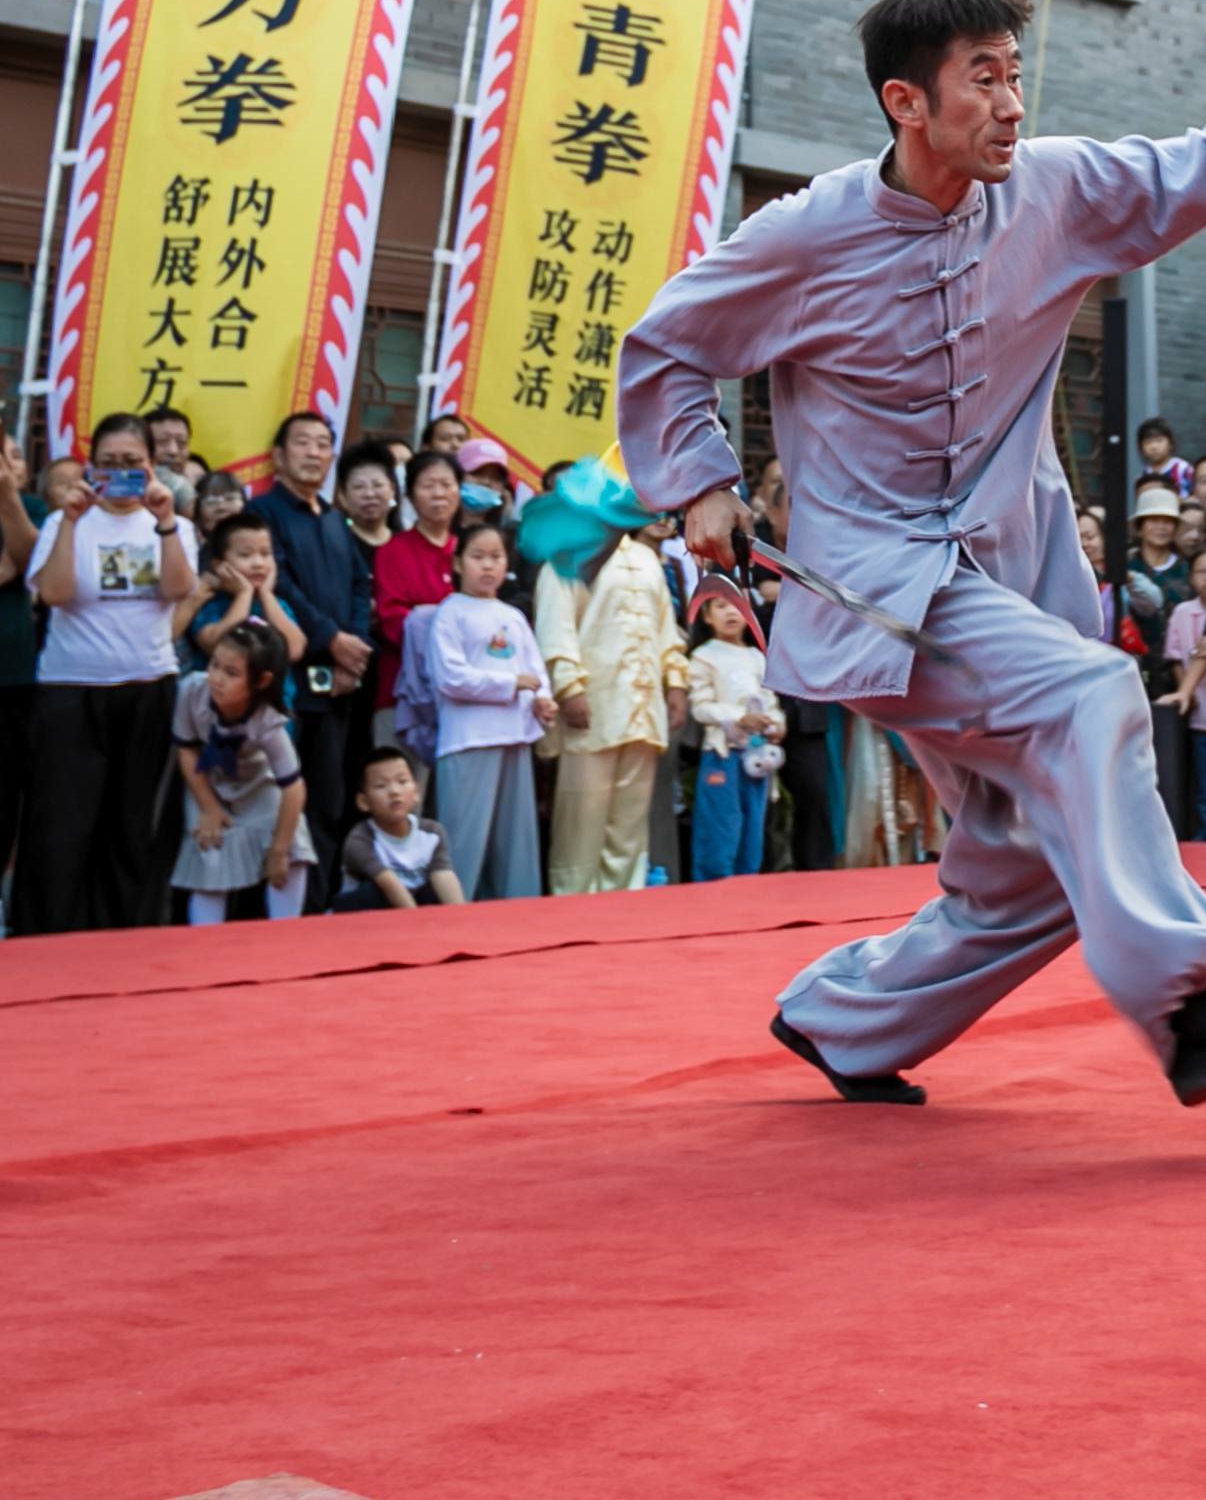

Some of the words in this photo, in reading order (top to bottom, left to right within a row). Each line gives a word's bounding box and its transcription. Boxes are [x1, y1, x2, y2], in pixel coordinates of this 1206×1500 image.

[136, 173, 212, 411] 舒展大方
[199, 177, 276, 389] 内外合一
[512, 208, 579, 411] 攻防灵活
[564, 219, 635, 422] 动作潇洒
